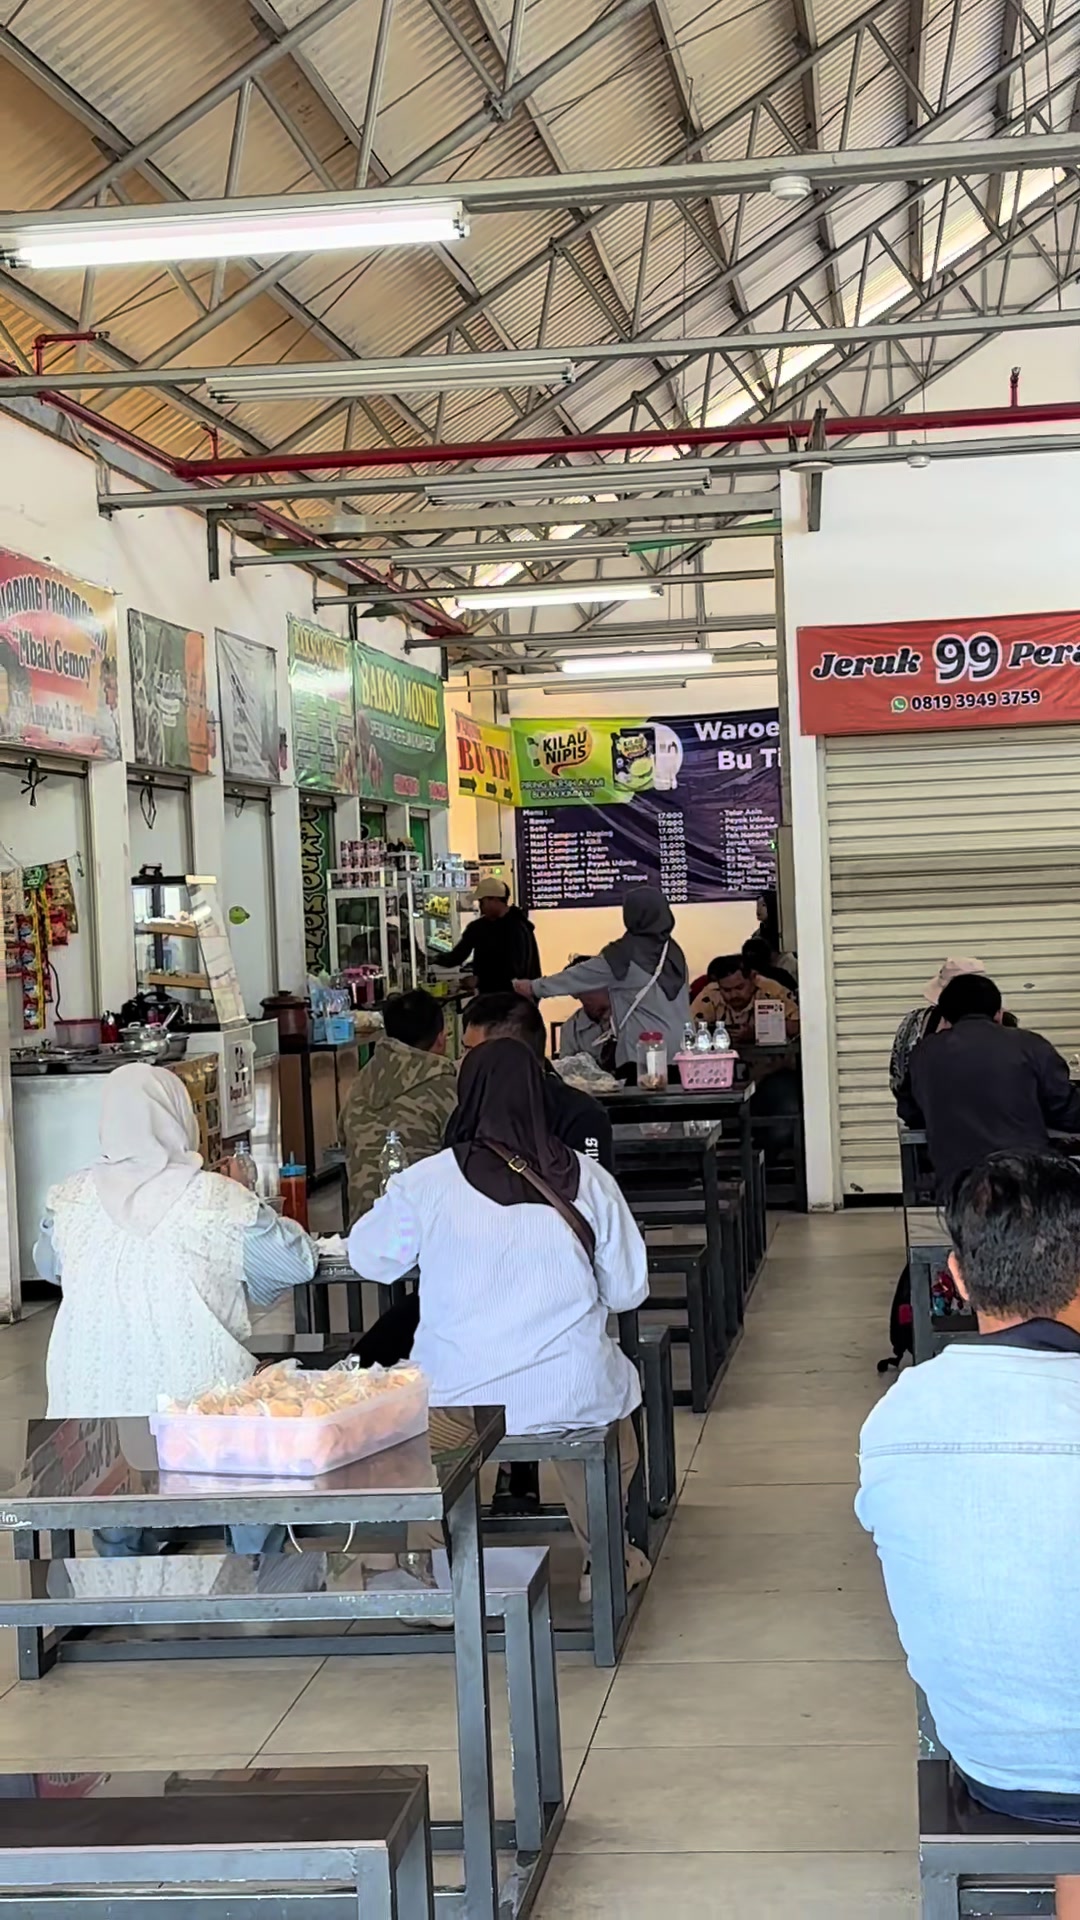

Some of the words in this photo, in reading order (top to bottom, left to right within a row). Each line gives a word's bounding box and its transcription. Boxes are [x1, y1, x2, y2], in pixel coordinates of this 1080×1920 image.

[813, 648, 920, 678] Jeruk
[937, 635, 999, 680] 99
[360, 661, 401, 717] BAKSO
[911, 696, 952, 710] 0819
[957, 694, 997, 708] 3949
[1002, 690, 1041, 705] 3759
[543, 730, 587, 751] KILAU
[694, 721, 780, 741] Waroe
[457, 737, 485, 774] BU
[546, 745, 586, 765] NIPIS
[718, 750, 752, 770] Bu
[0, 1510, 18, 1523] im
